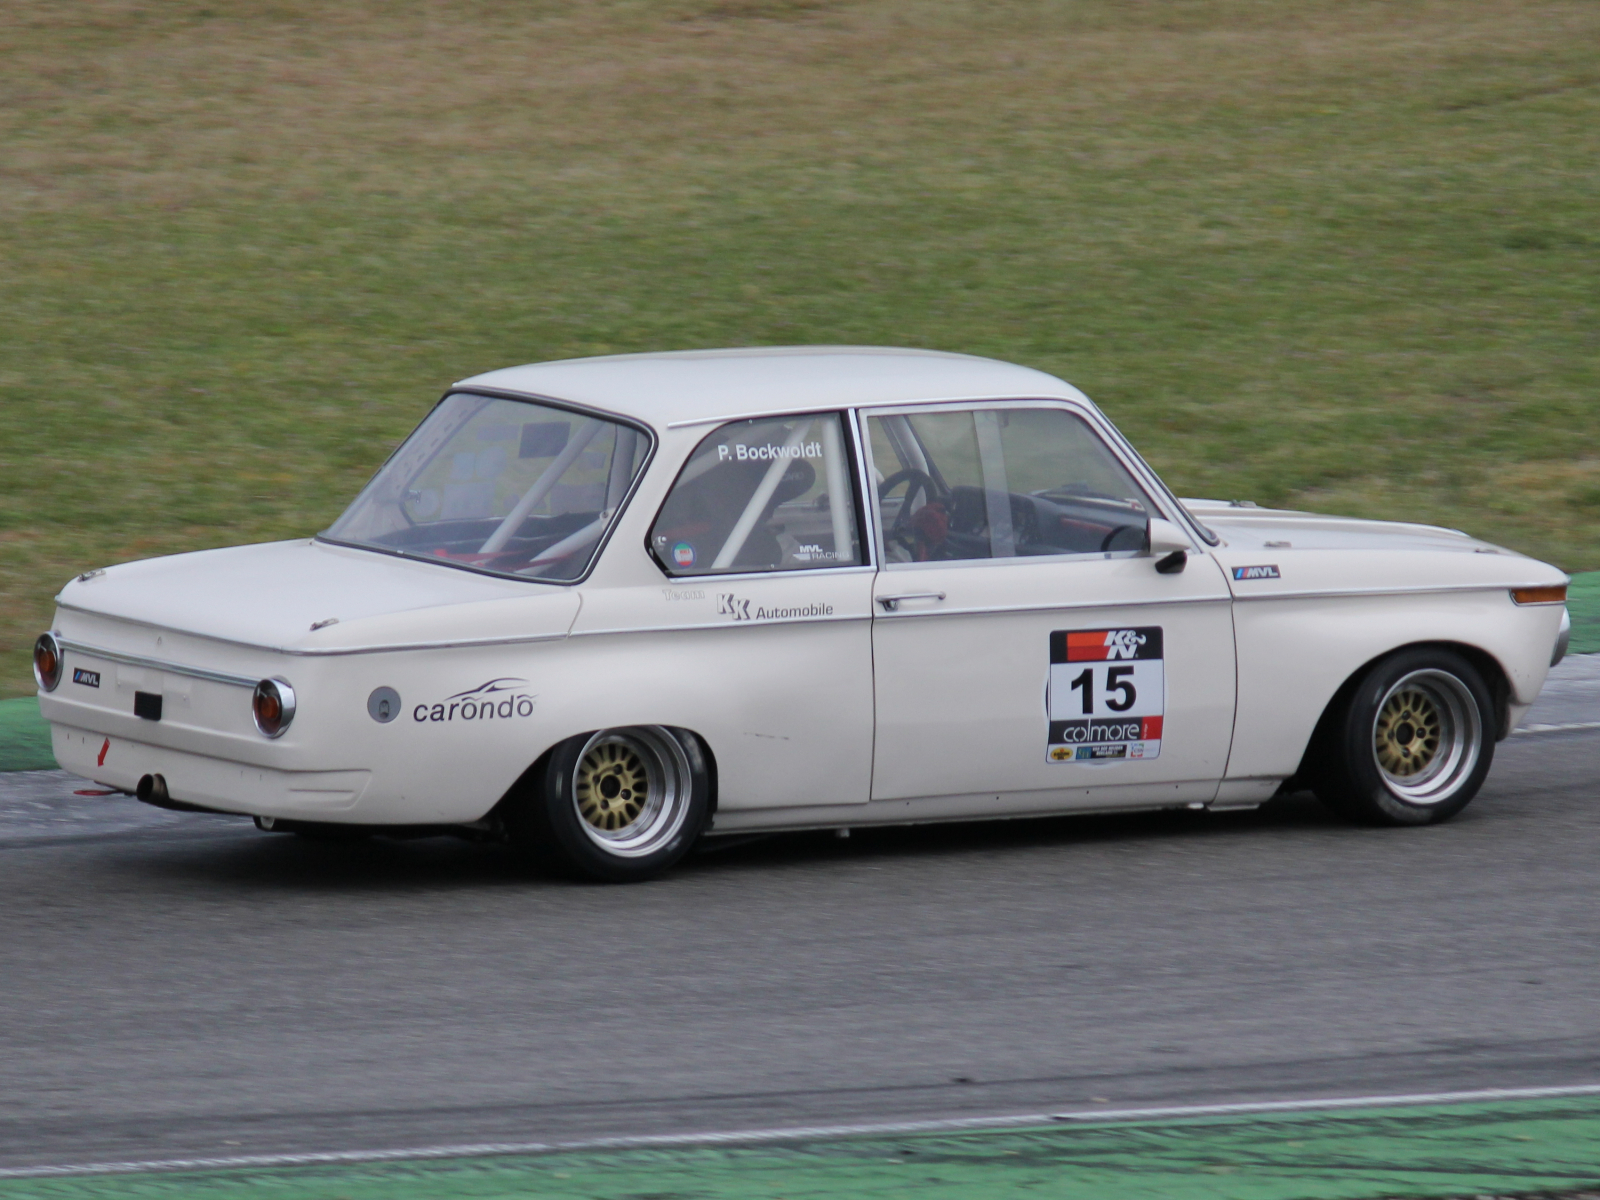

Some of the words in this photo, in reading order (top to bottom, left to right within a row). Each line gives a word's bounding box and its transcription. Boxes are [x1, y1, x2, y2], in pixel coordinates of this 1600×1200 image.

[717, 444, 733, 461] P.
[735, 441, 823, 461] Bockwoldt
[799, 544, 823, 554] MVL
[811, 551, 850, 560] RACING
[1246, 566, 1279, 578] MVL
[661, 588, 706, 601] Team
[755, 602, 834, 620] Automobile
[1103, 629, 1147, 660] K&N
[80, 672, 99, 685] MVL
[1070, 665, 1137, 715] 15
[1063, 718, 1140, 743] colmore
